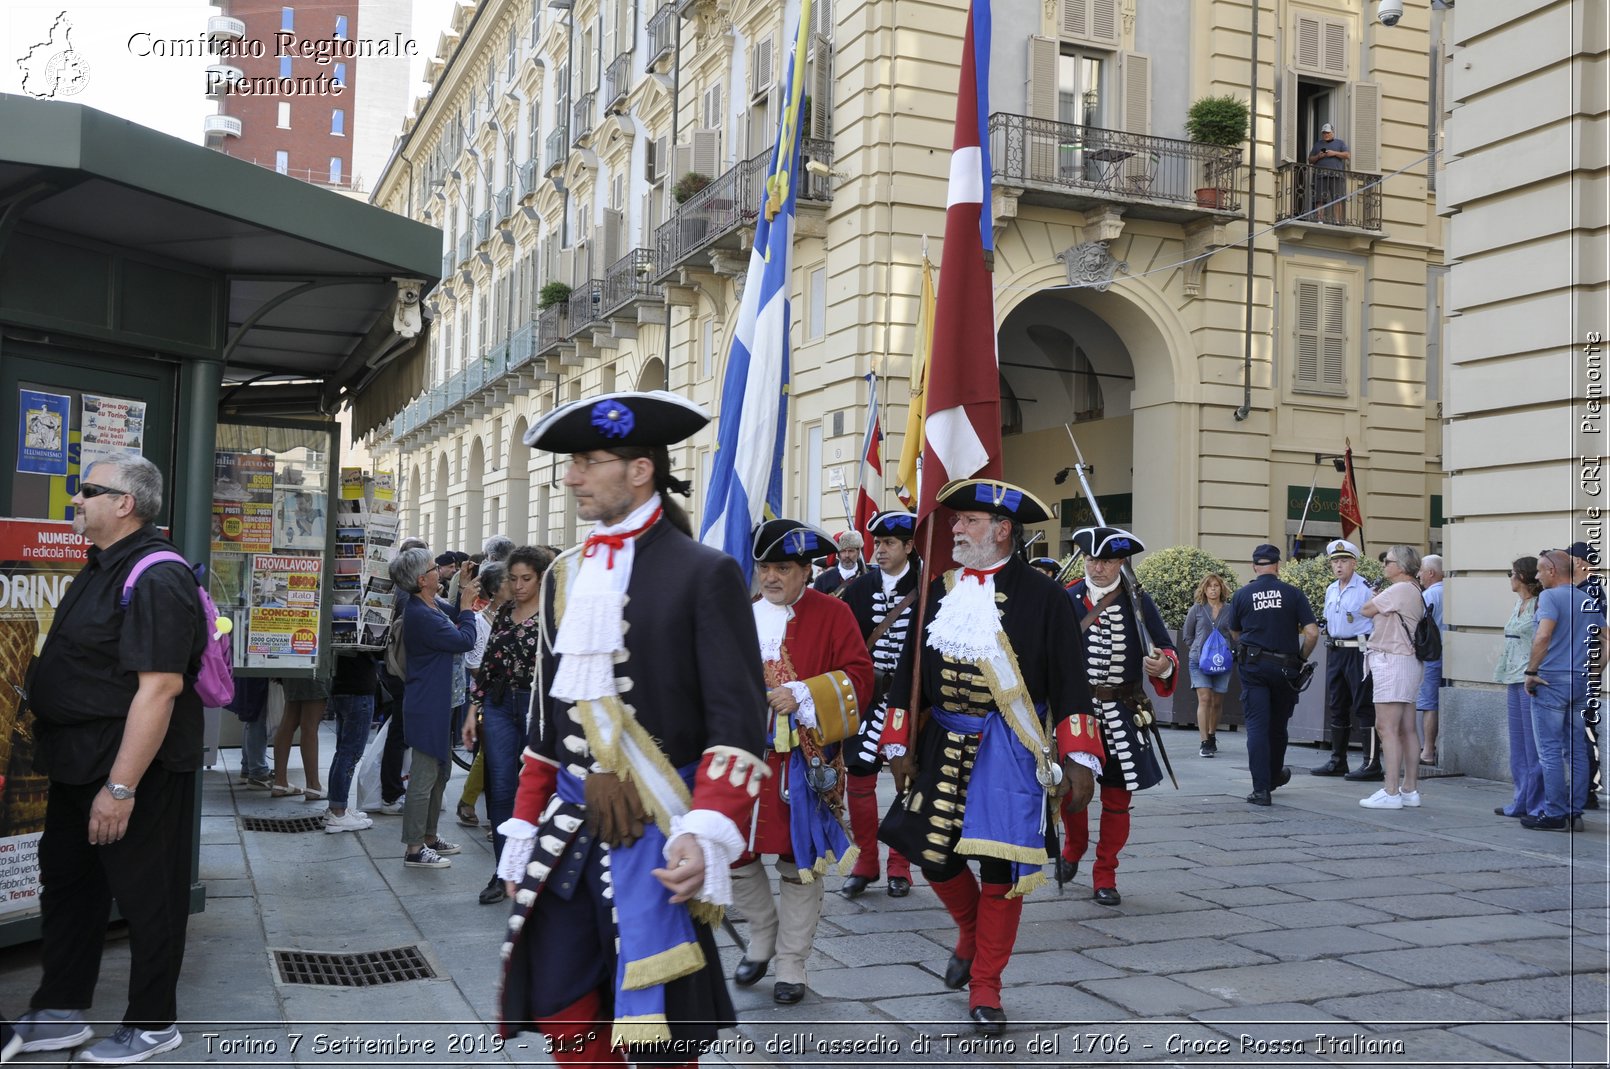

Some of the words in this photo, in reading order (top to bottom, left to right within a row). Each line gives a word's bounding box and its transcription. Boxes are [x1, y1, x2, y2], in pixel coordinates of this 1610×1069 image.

[107, 411, 127, 419] Torino
[23, 448, 63, 458] ILLUMINISMO
[38, 532, 82, 545] NUMERO
[23, 545, 31, 557] in
[32, 545, 64, 558] edicola
[65, 546, 82, 558] fino
[257, 558, 319, 571] TROVALAVORO
[1252, 590, 1282, 602] POLIZIA
[1253, 599, 1282, 611] LOCALE
[261, 609, 310, 617] CONCORSI
[295, 632, 314, 641] 1100
[0, 844, 16, 853] ora,
[8, 854, 20, 865] sul
[9, 887, 36, 900] Tennis
